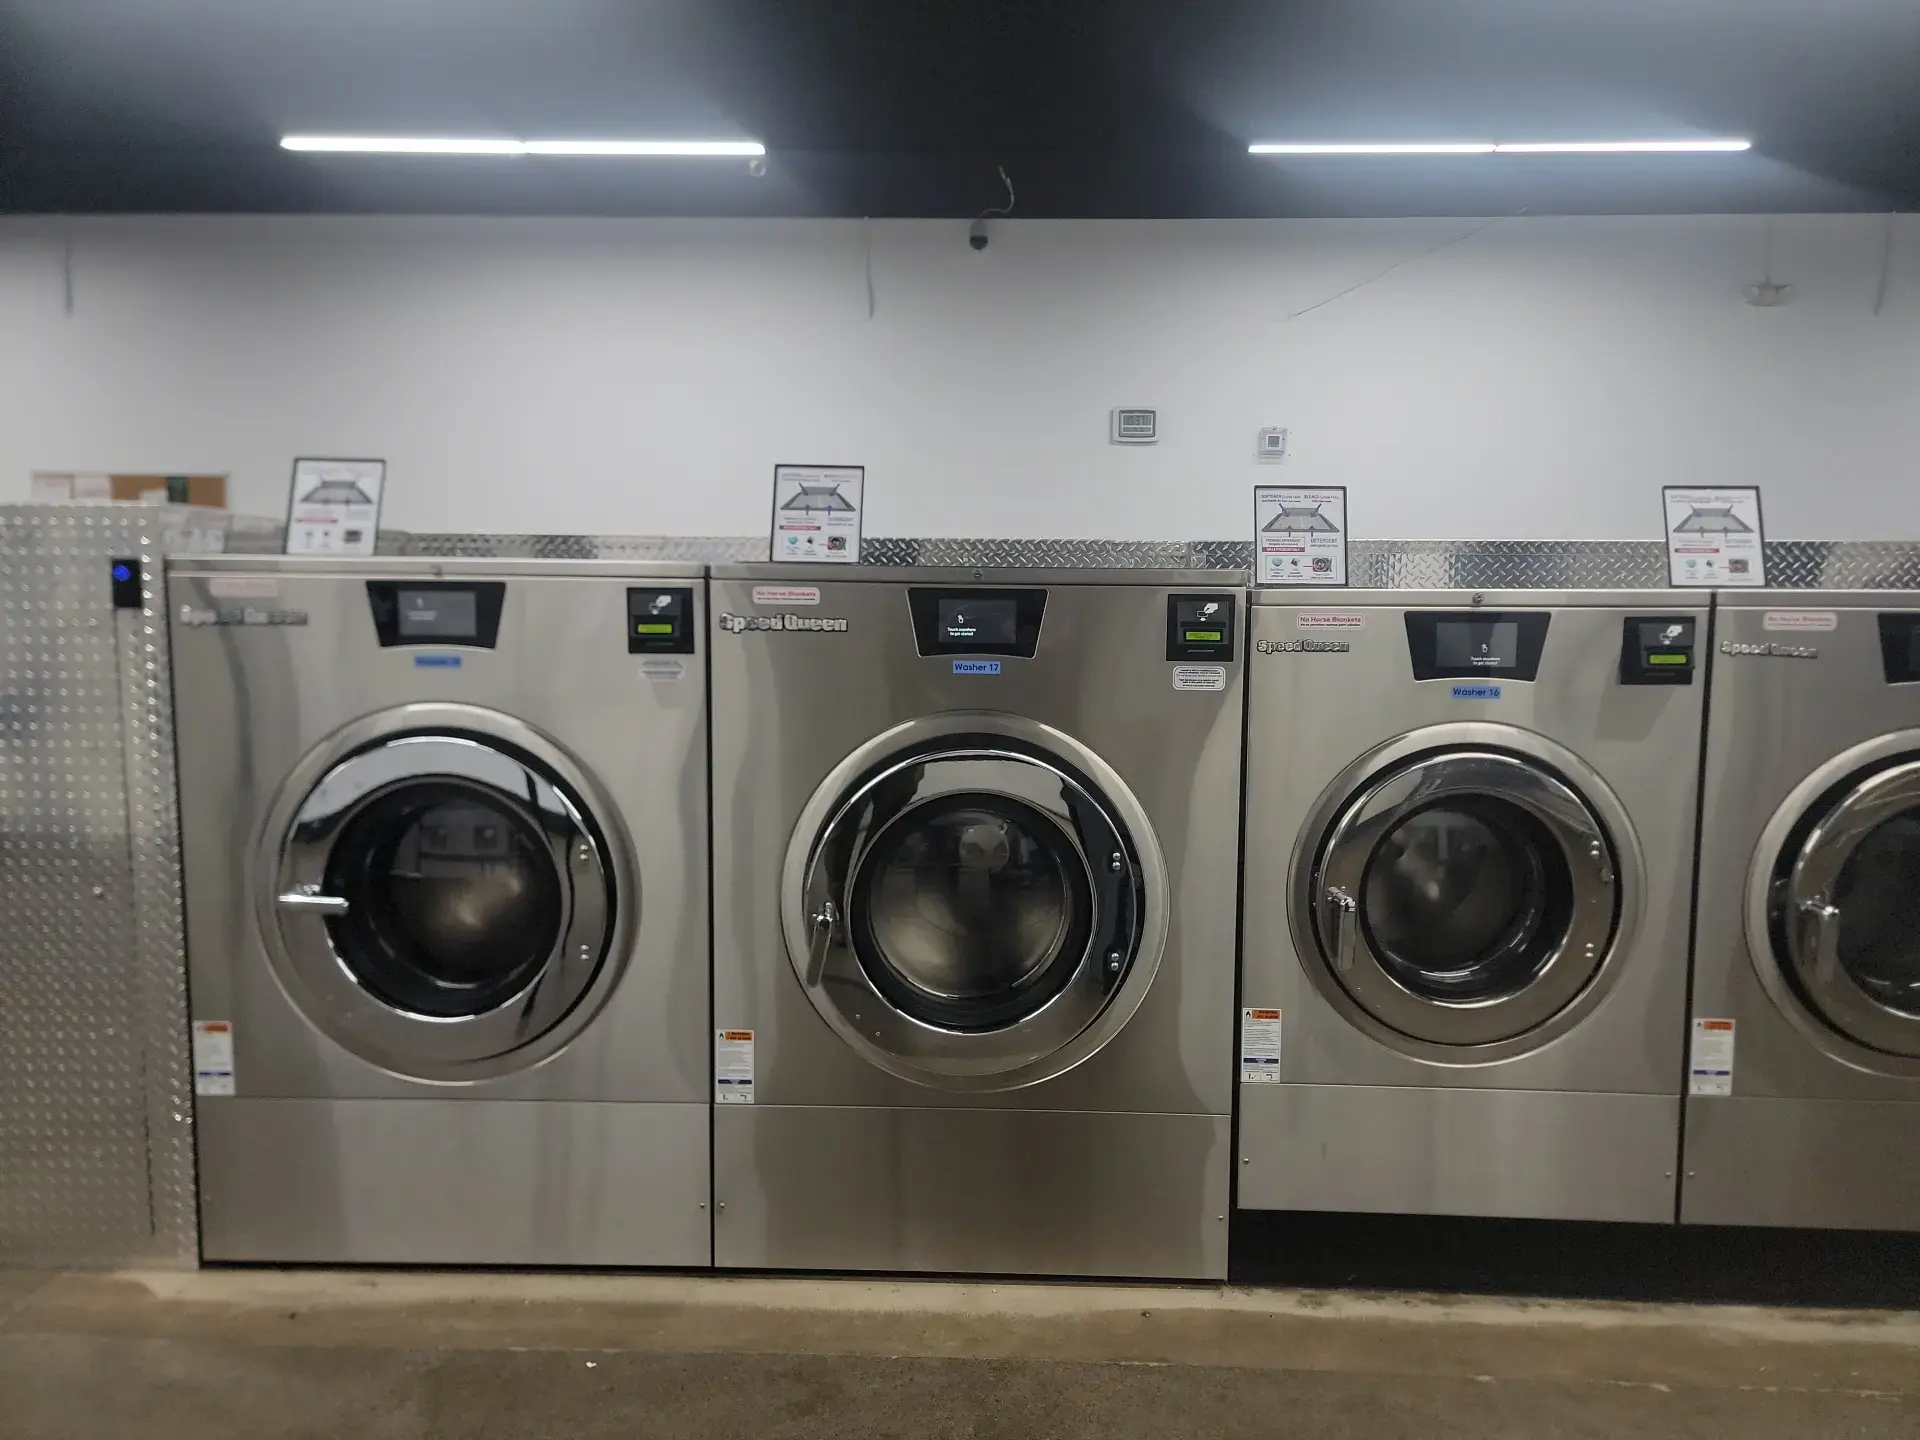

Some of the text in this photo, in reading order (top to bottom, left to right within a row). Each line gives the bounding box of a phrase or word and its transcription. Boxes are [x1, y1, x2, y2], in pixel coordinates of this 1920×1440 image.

[784, 613, 848, 632] Queen
[1257, 640, 1303, 654] Speed
[1721, 641, 1769, 656] Speed
[954, 663, 986, 671] Washer
[1453, 688, 1499, 696] Washer 16
